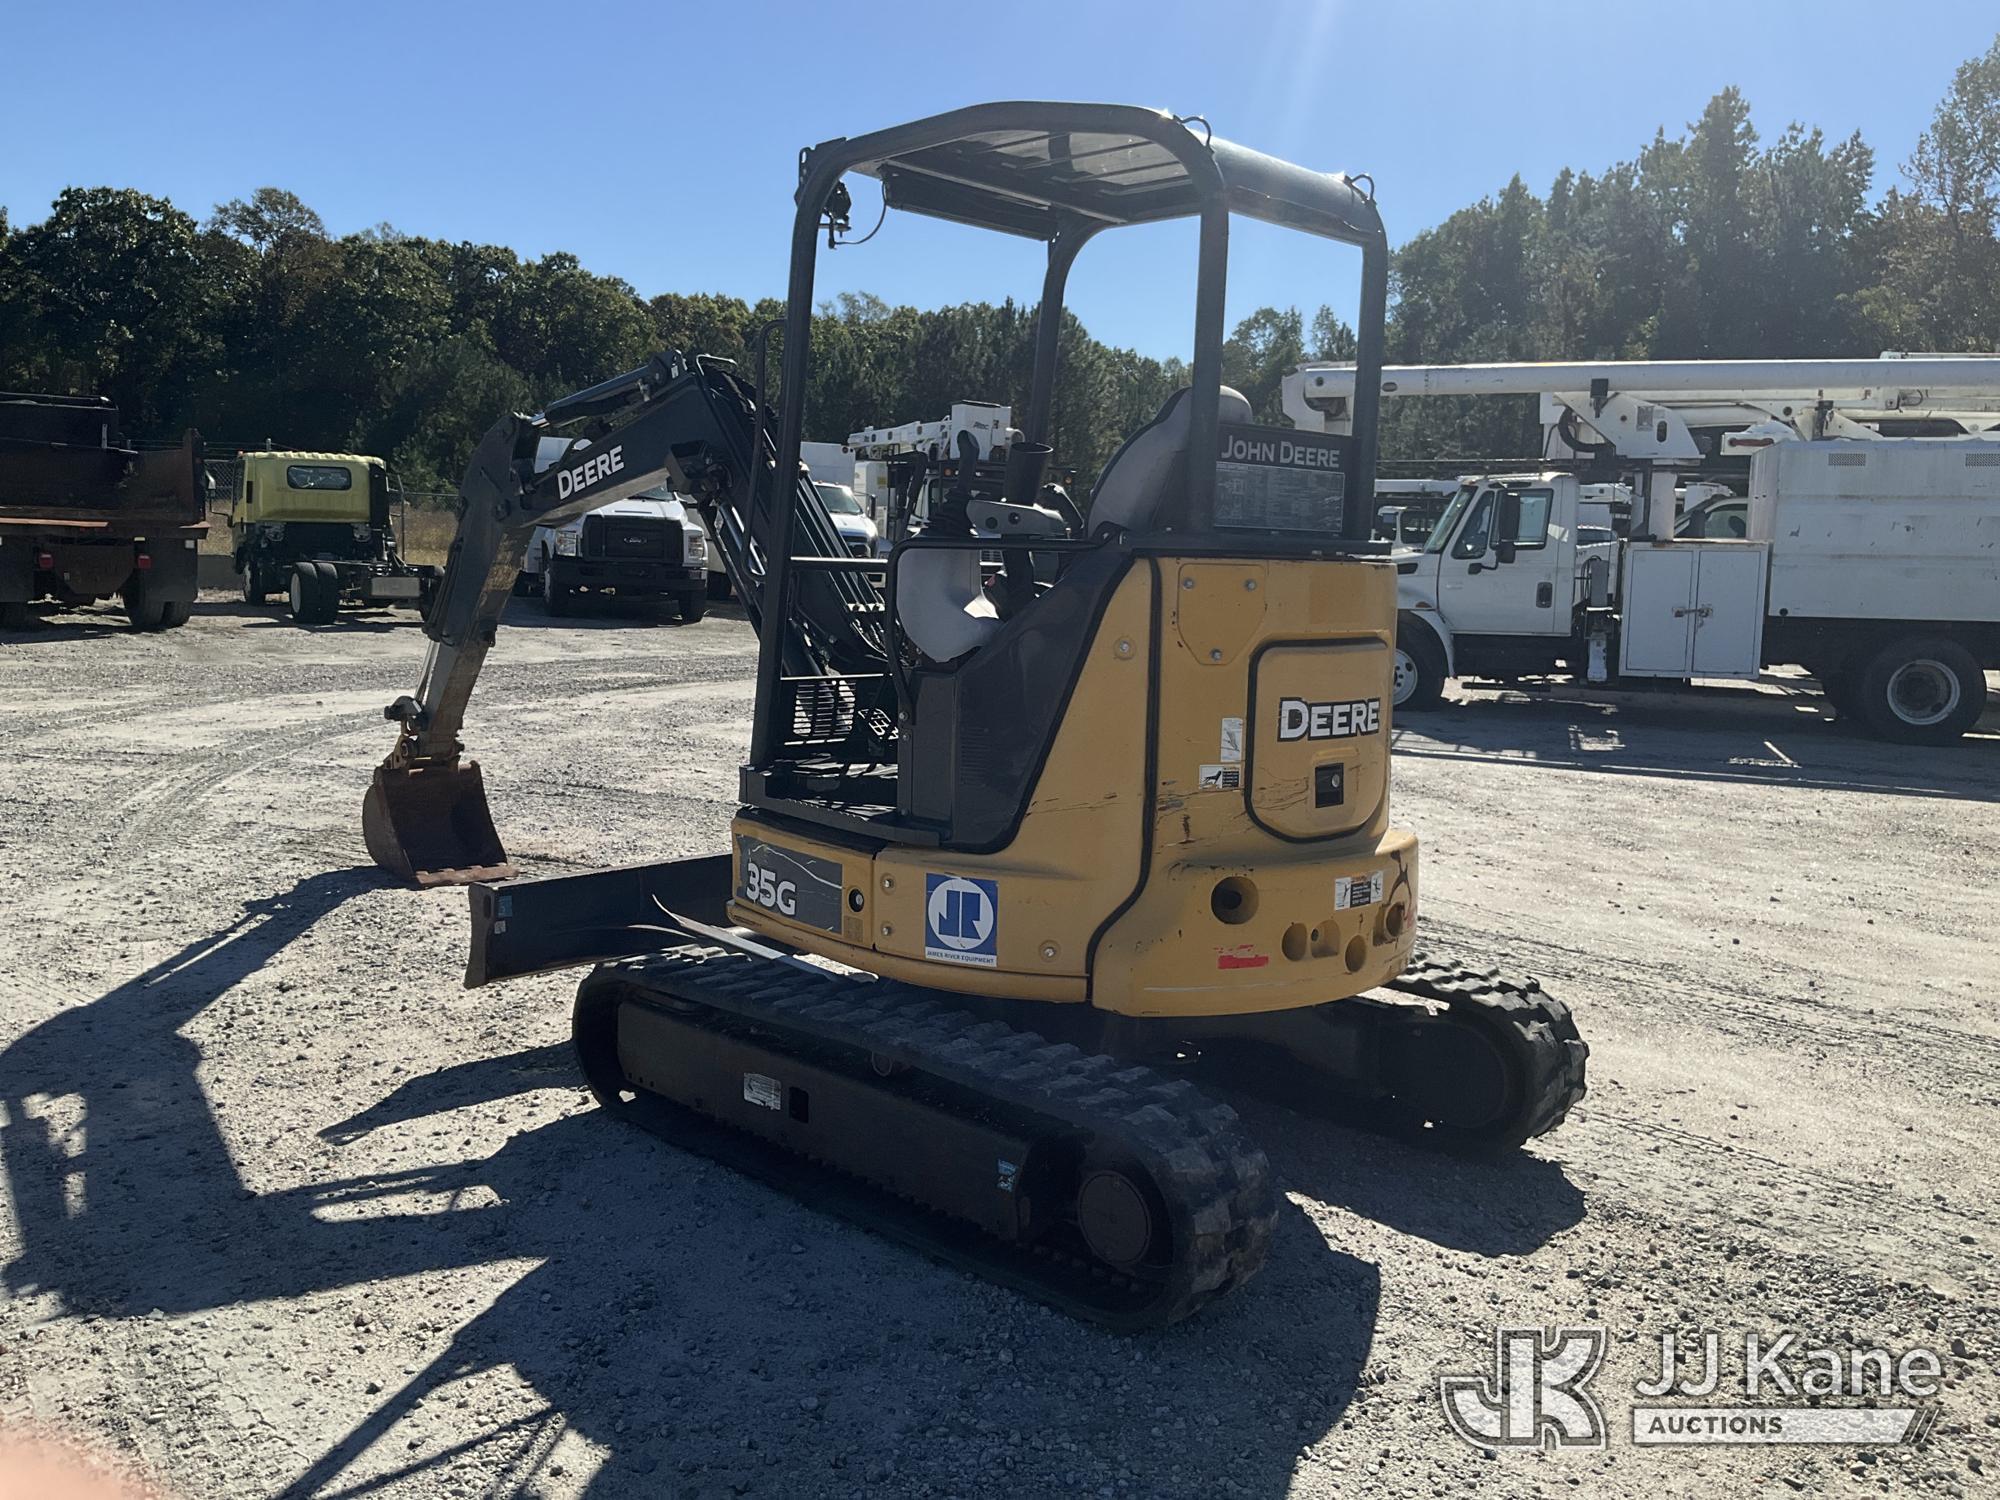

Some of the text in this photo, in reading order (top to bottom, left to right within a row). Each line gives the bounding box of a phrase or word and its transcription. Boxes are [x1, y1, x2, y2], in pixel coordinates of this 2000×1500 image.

[1220, 434, 1340, 468] JOHN DEERE
[557, 445, 625, 500] DEERE
[1279, 699, 1380, 740] DEERE
[746, 862, 797, 916] 35G
[961, 955, 994, 964] EQUIPMENT
